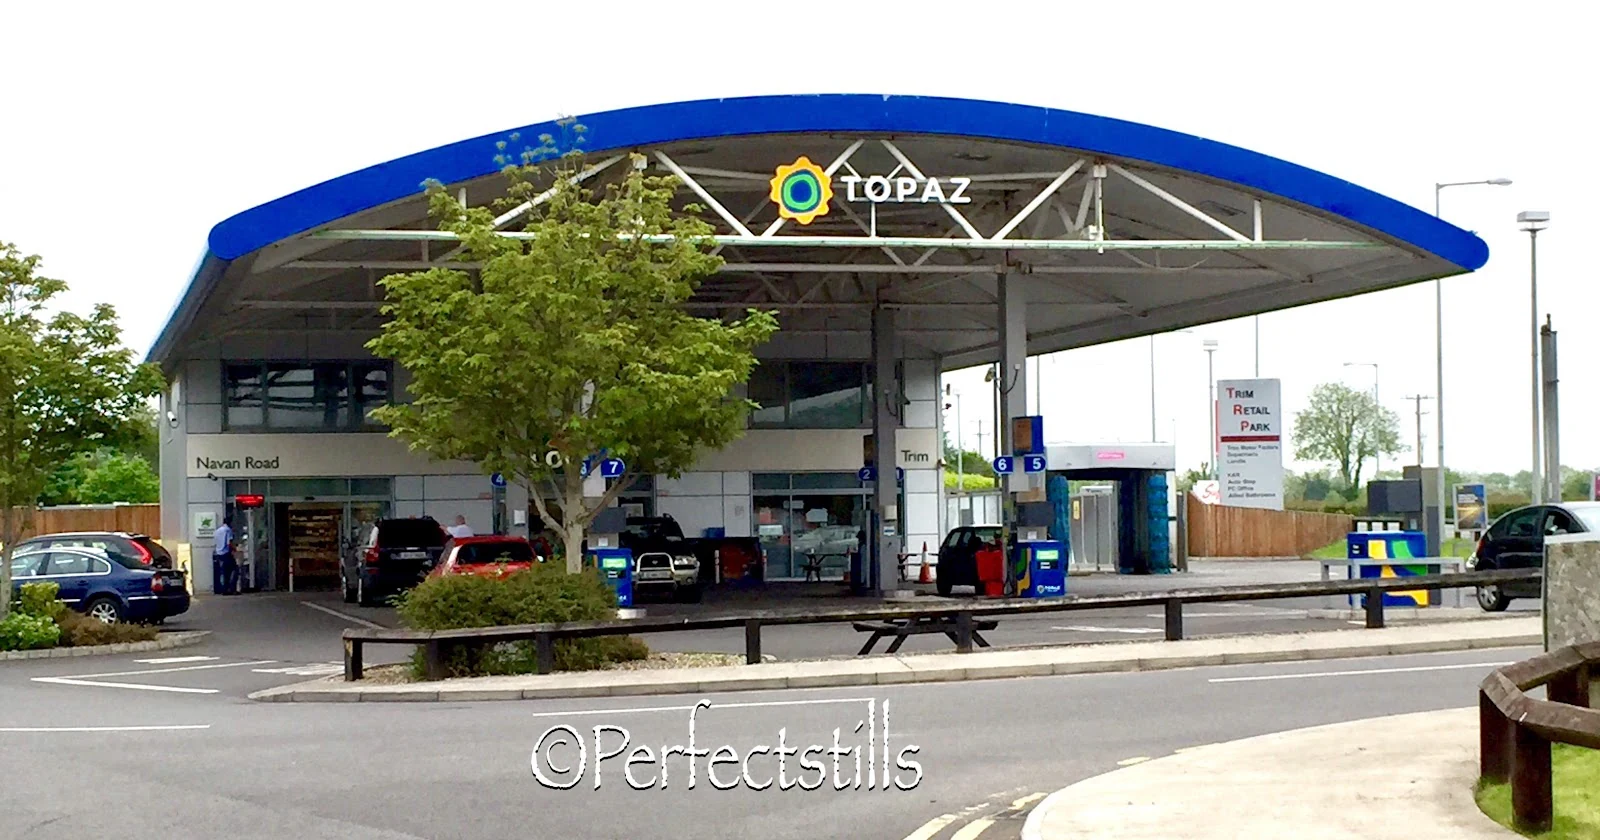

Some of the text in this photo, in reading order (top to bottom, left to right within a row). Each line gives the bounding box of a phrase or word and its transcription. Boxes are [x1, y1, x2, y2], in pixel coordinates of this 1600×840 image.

[840, 175, 972, 204] TOPAZ
[1226, 387, 1254, 399] TRIM
[1233, 404, 1270, 415] RETAIL
[1240, 420, 1270, 432] PARK
[196, 455, 280, 469] Navan Road
[901, 450, 929, 462] Trim
[608, 461, 619, 474] 7
[998, 458, 1007, 470] 6
[1032, 458, 1042, 470] 5
[495, 474, 503, 485] 4
[862, 469, 870, 479] 2
